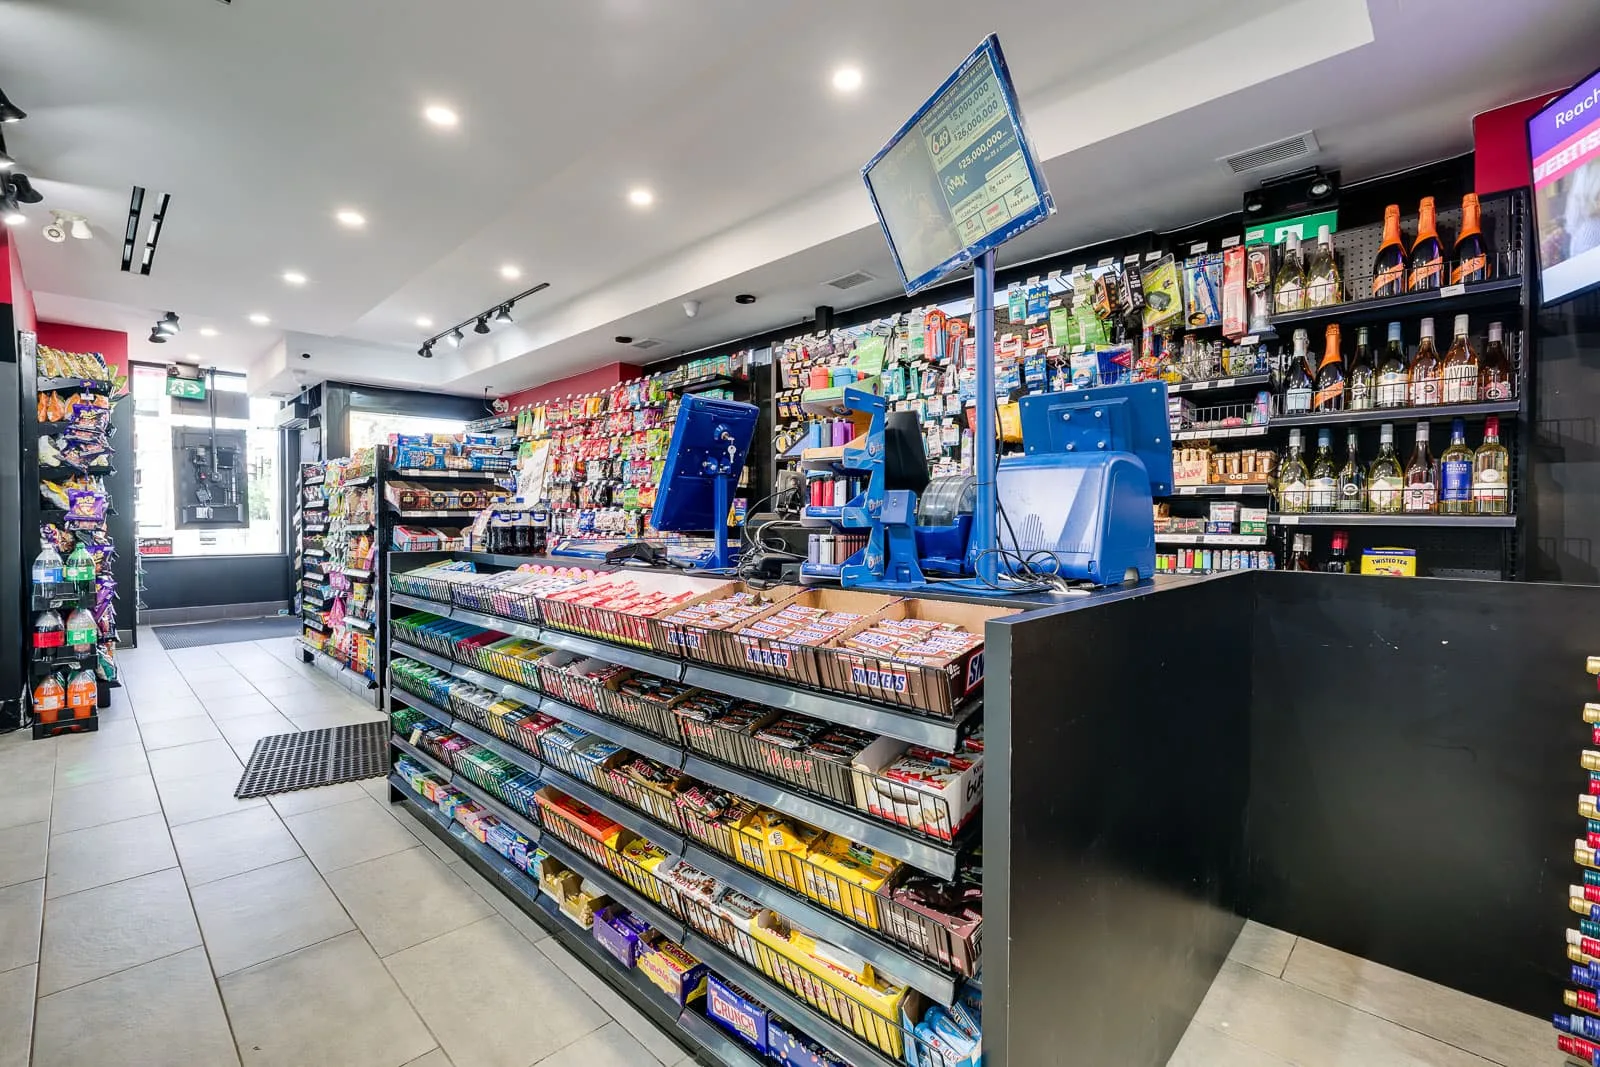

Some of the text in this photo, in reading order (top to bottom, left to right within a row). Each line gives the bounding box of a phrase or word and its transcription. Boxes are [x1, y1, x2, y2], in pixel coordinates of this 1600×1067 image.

[1555, 88, 1600, 129] Reach
[668, 631, 699, 649] SNICERS
[747, 648, 788, 668] SNICKERS
[852, 668, 905, 691] SNICKERS
[767, 748, 813, 774] Mars
[902, 760, 935, 771] bueno
[712, 997, 756, 1032] CRUNCH
